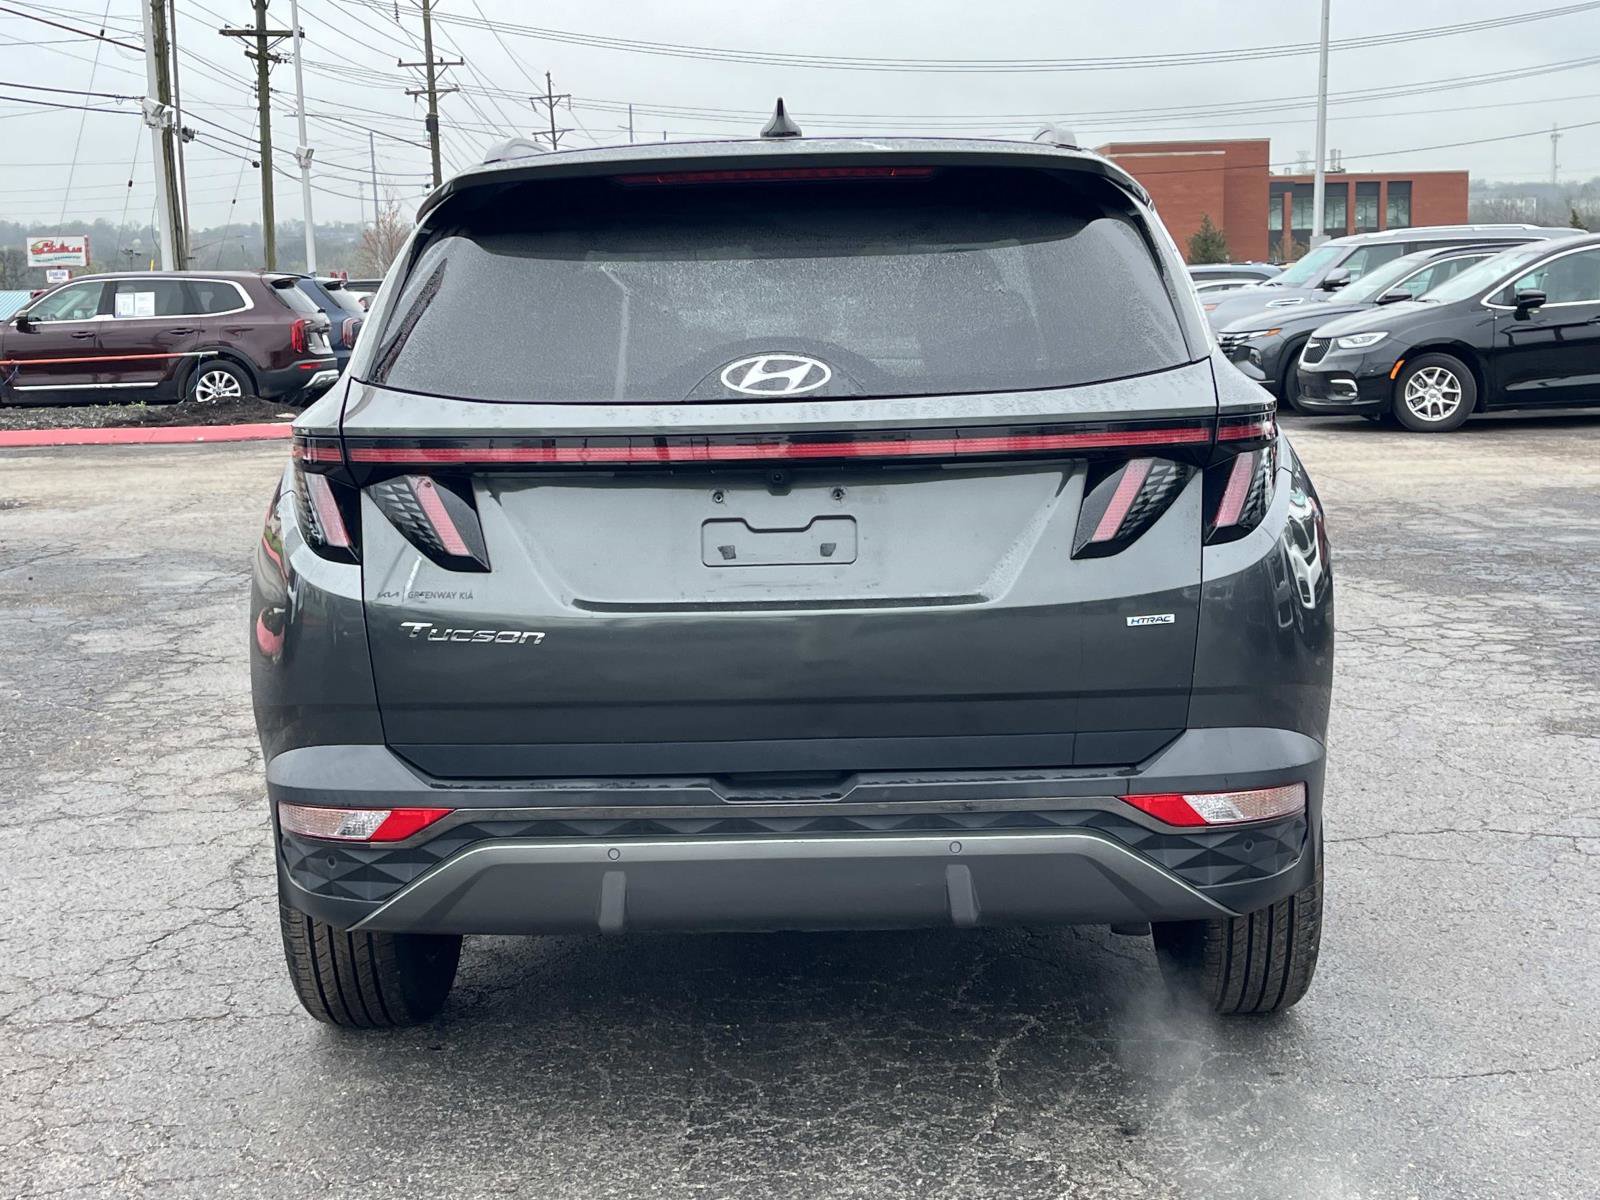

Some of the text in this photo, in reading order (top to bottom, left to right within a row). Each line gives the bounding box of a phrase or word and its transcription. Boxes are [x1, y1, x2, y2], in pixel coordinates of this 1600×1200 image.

[407, 590, 474, 600] GREENWAY KIA
[1130, 615, 1172, 625] HTRAC
